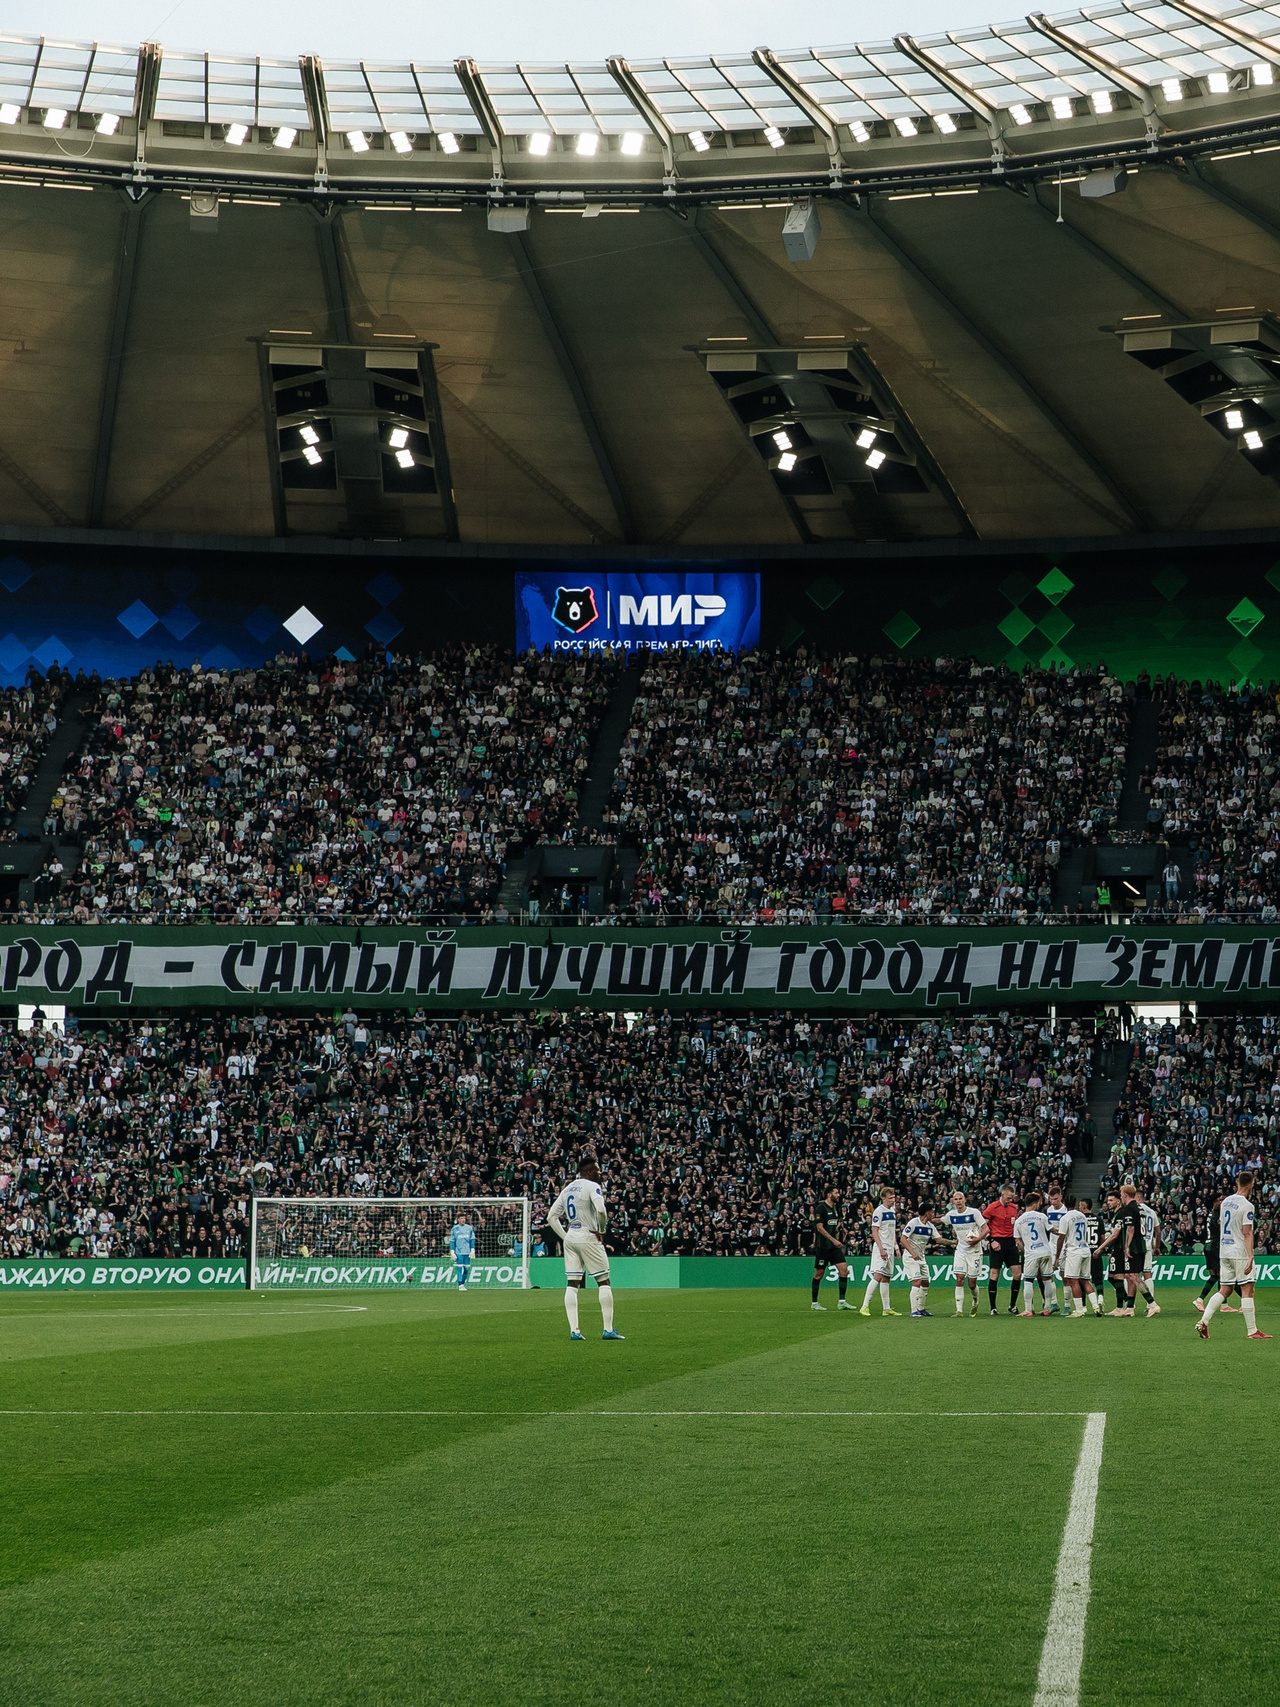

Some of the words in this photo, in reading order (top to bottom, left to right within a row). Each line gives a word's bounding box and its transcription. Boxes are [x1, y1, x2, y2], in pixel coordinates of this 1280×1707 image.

[619, 594, 727, 626] МИР
[219, 929, 459, 996] САМЫЙ
[481, 929, 752, 1000] ЛУЧШИЙ
[775, 937, 974, 1006] ГОРОД
[996, 938, 1081, 991] НА
[566, 1195, 577, 1220] 6
[1028, 1222, 1039, 1241] 3
[1074, 1222, 1086, 1242] 37
[1223, 1210, 1232, 1235] 2
[1086, 1226, 1099, 1245] 15
[91, 1267, 192, 1285] ВТОРУЮ
[420, 1266, 523, 1284] БИЕТОВ
